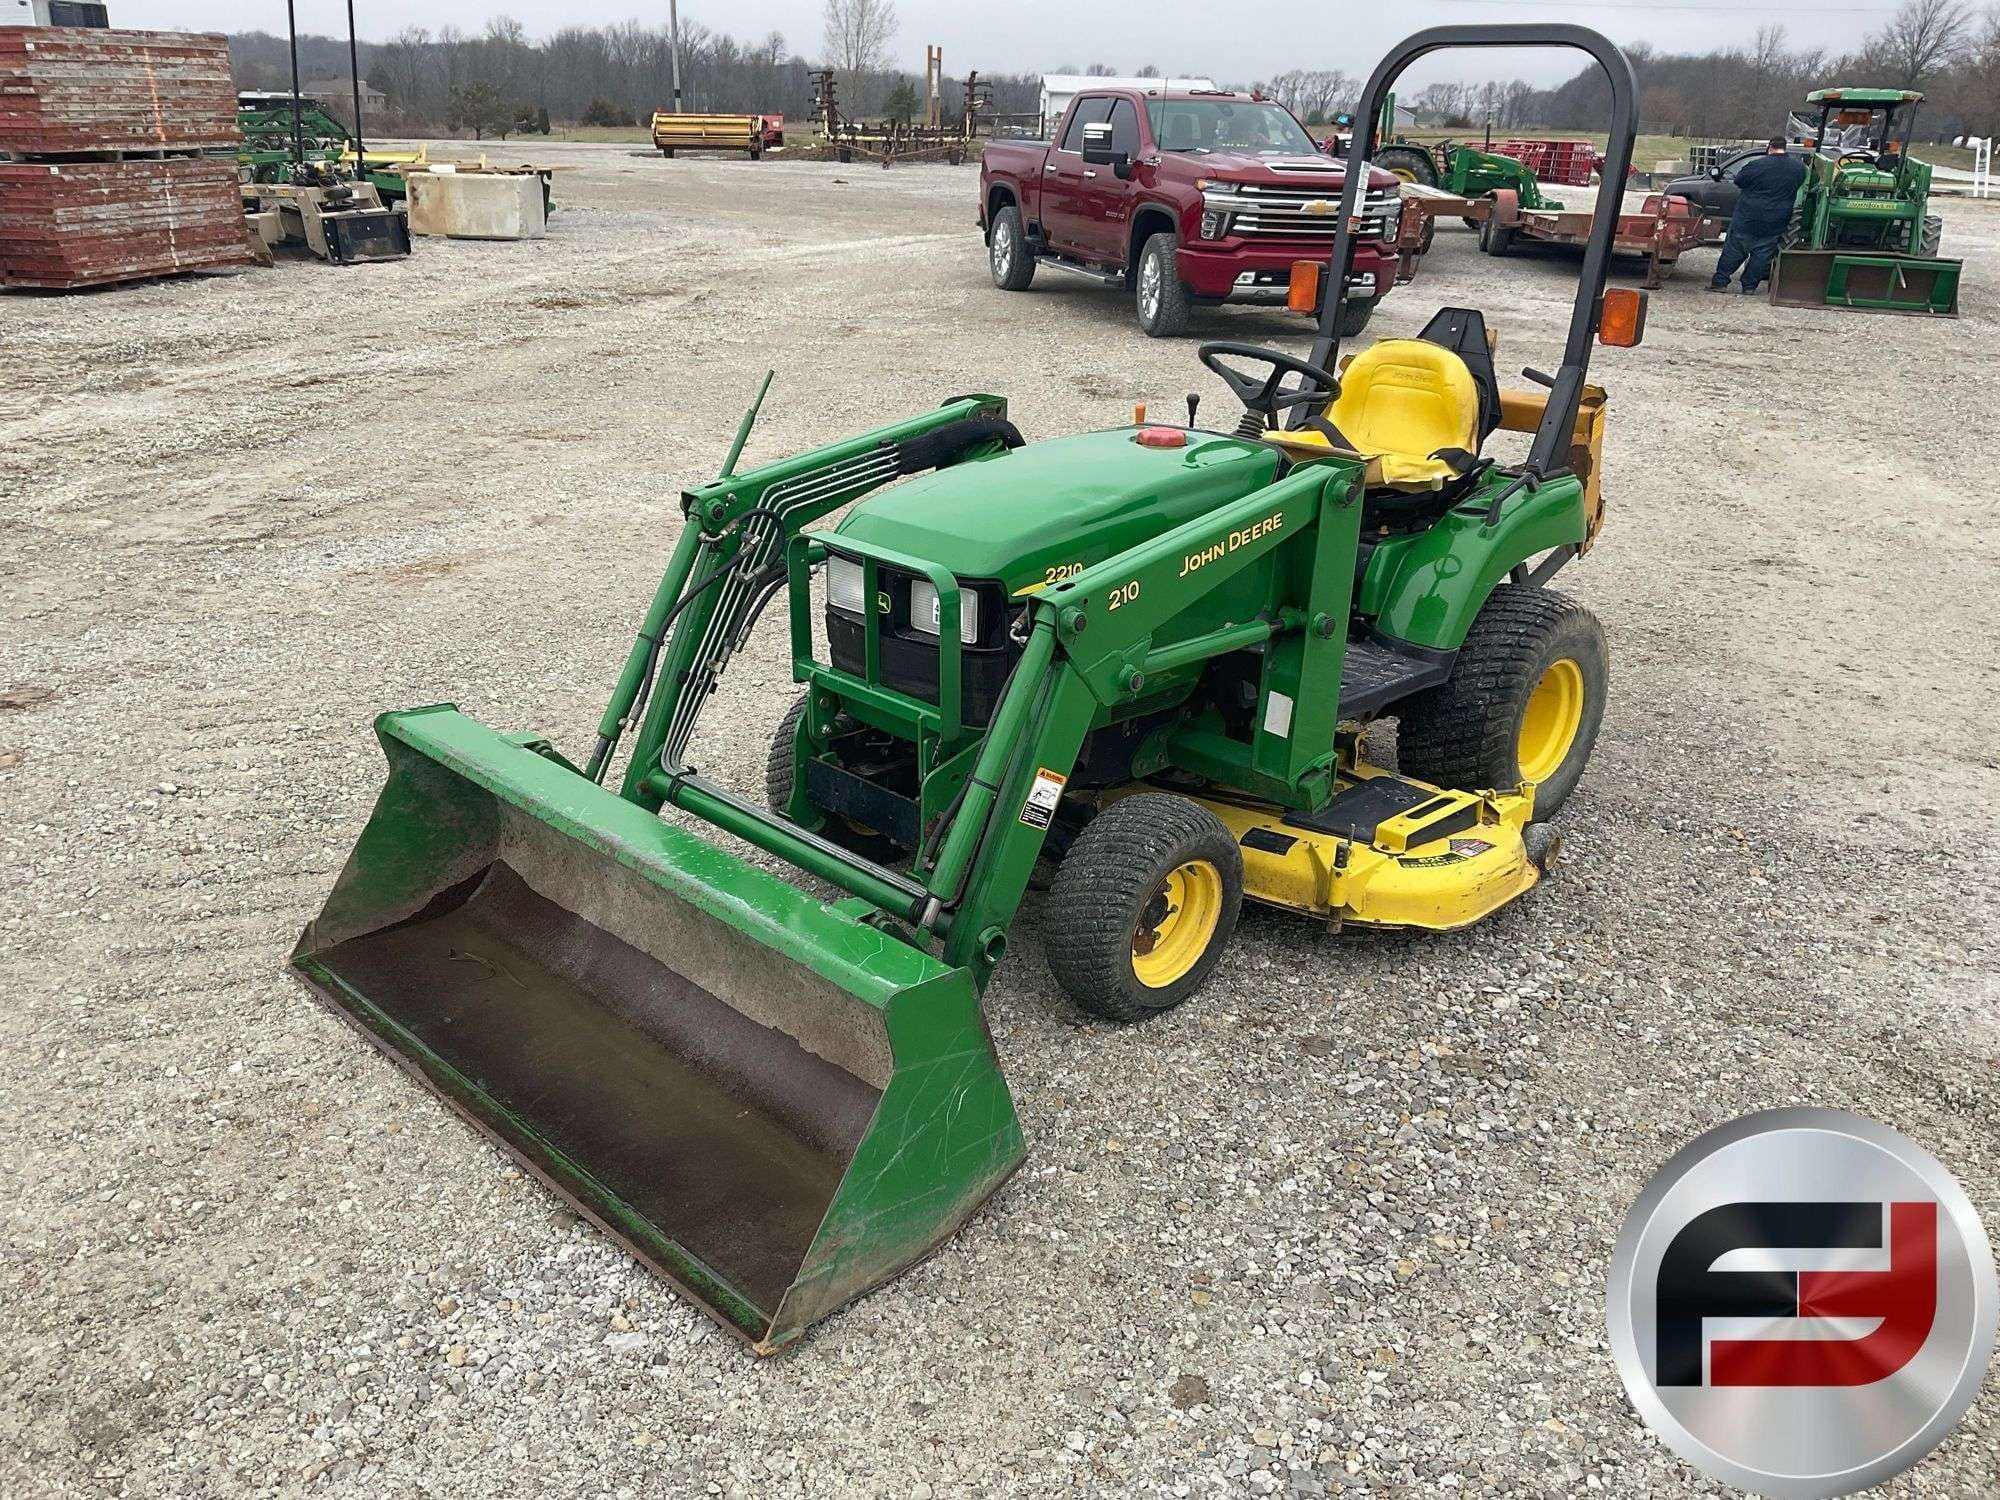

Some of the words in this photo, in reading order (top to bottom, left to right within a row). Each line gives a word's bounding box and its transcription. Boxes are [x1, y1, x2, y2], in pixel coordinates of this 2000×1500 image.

[1179, 541, 1225, 578] JOHN
[1228, 512, 1283, 552] DEERE
[1045, 562, 1083, 584] 2210
[1108, 580, 1140, 611] 210
